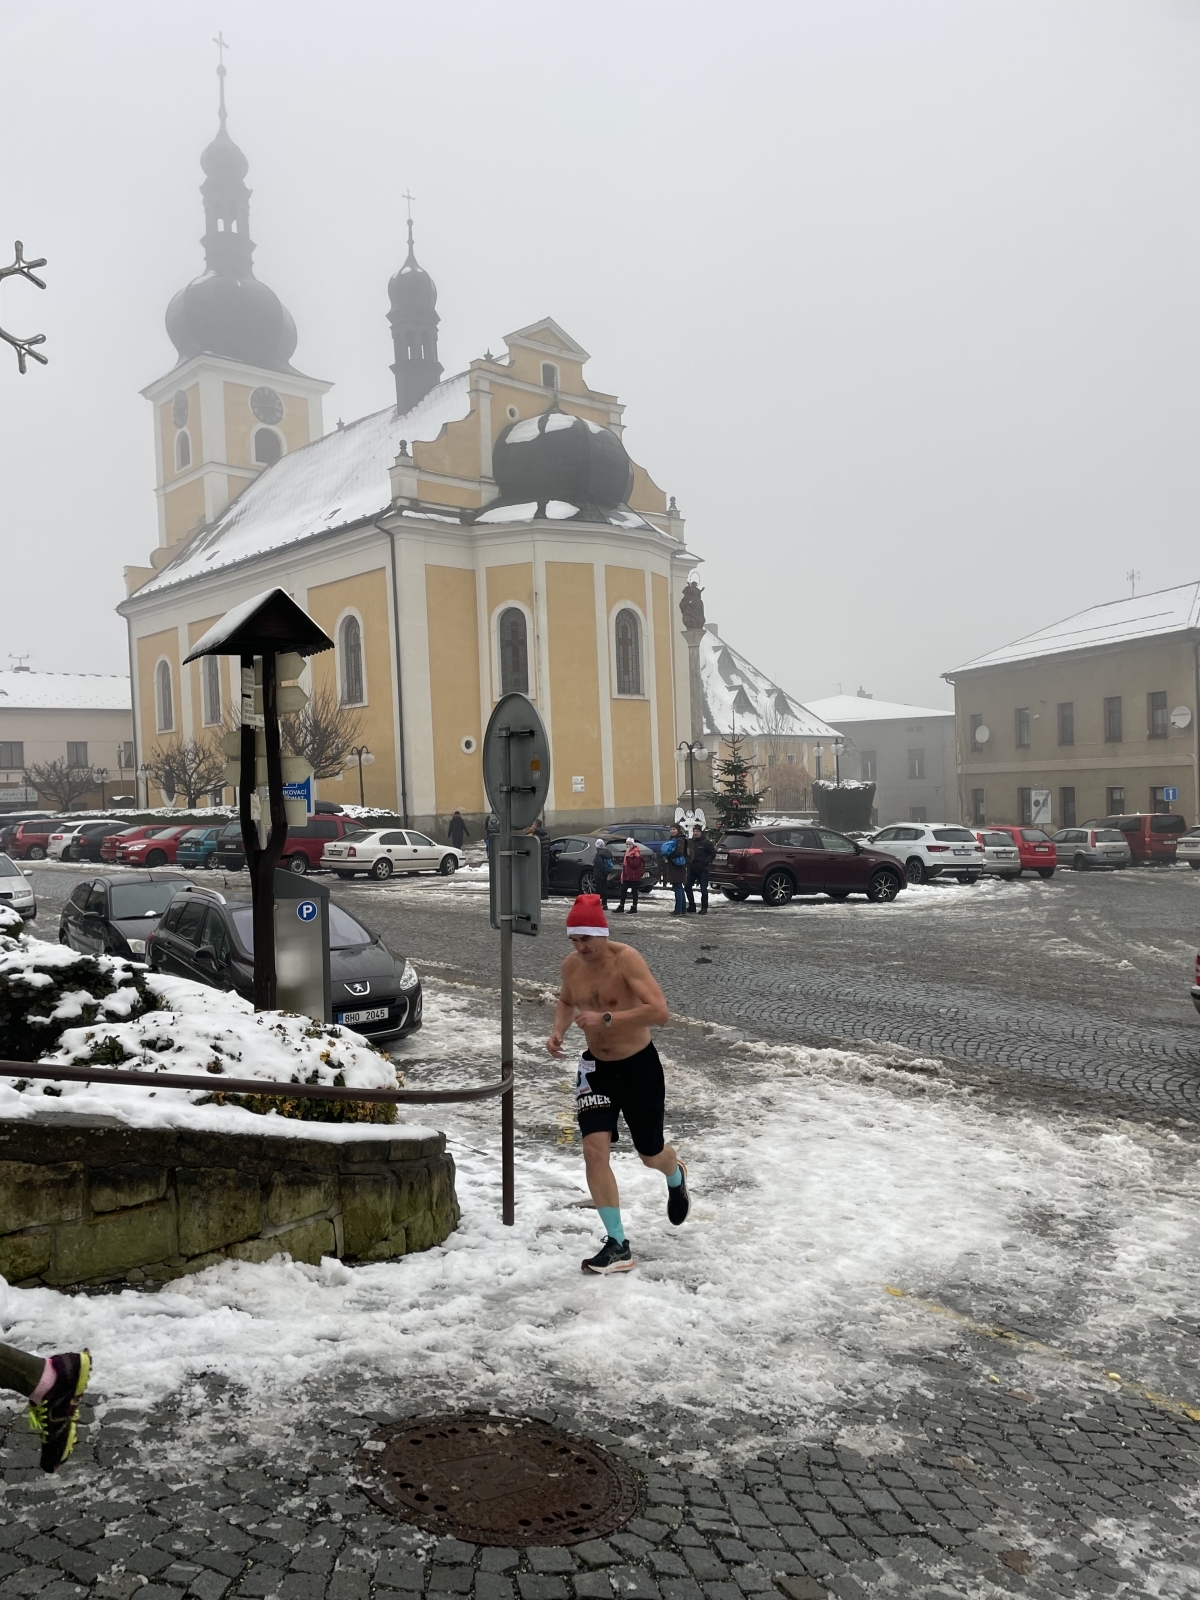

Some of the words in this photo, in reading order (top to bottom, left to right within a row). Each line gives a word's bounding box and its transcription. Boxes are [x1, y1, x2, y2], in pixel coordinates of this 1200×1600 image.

[302, 904, 313, 918] P
[345, 1013, 360, 1023] 8H0
[365, 1009, 385, 1020] 2045
